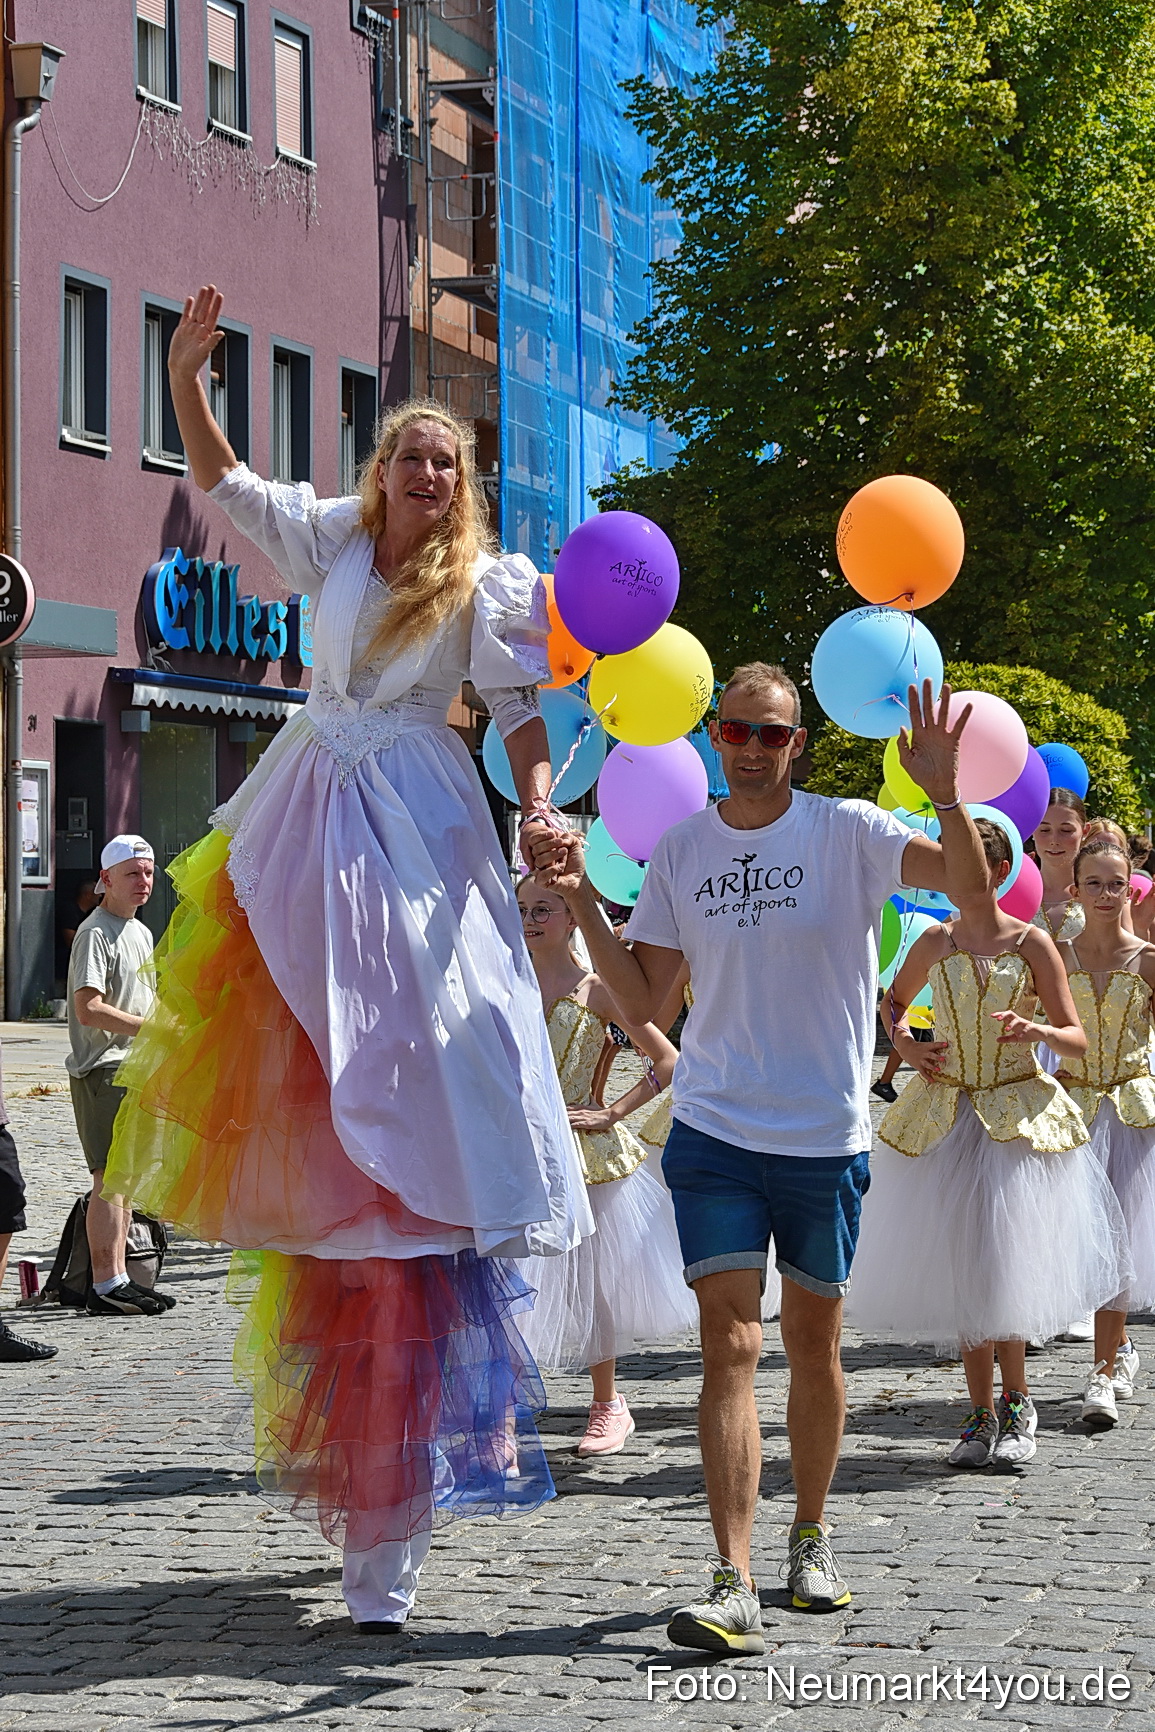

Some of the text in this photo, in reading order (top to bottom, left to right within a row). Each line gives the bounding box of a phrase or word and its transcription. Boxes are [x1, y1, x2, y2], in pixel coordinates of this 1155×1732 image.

[609, 558, 664, 587] ARTICO
[148, 546, 289, 663] Eilles
[693, 852, 804, 902] ARTICO
[704, 895, 798, 918] art of sports
[737, 914, 761, 928] e.V.
